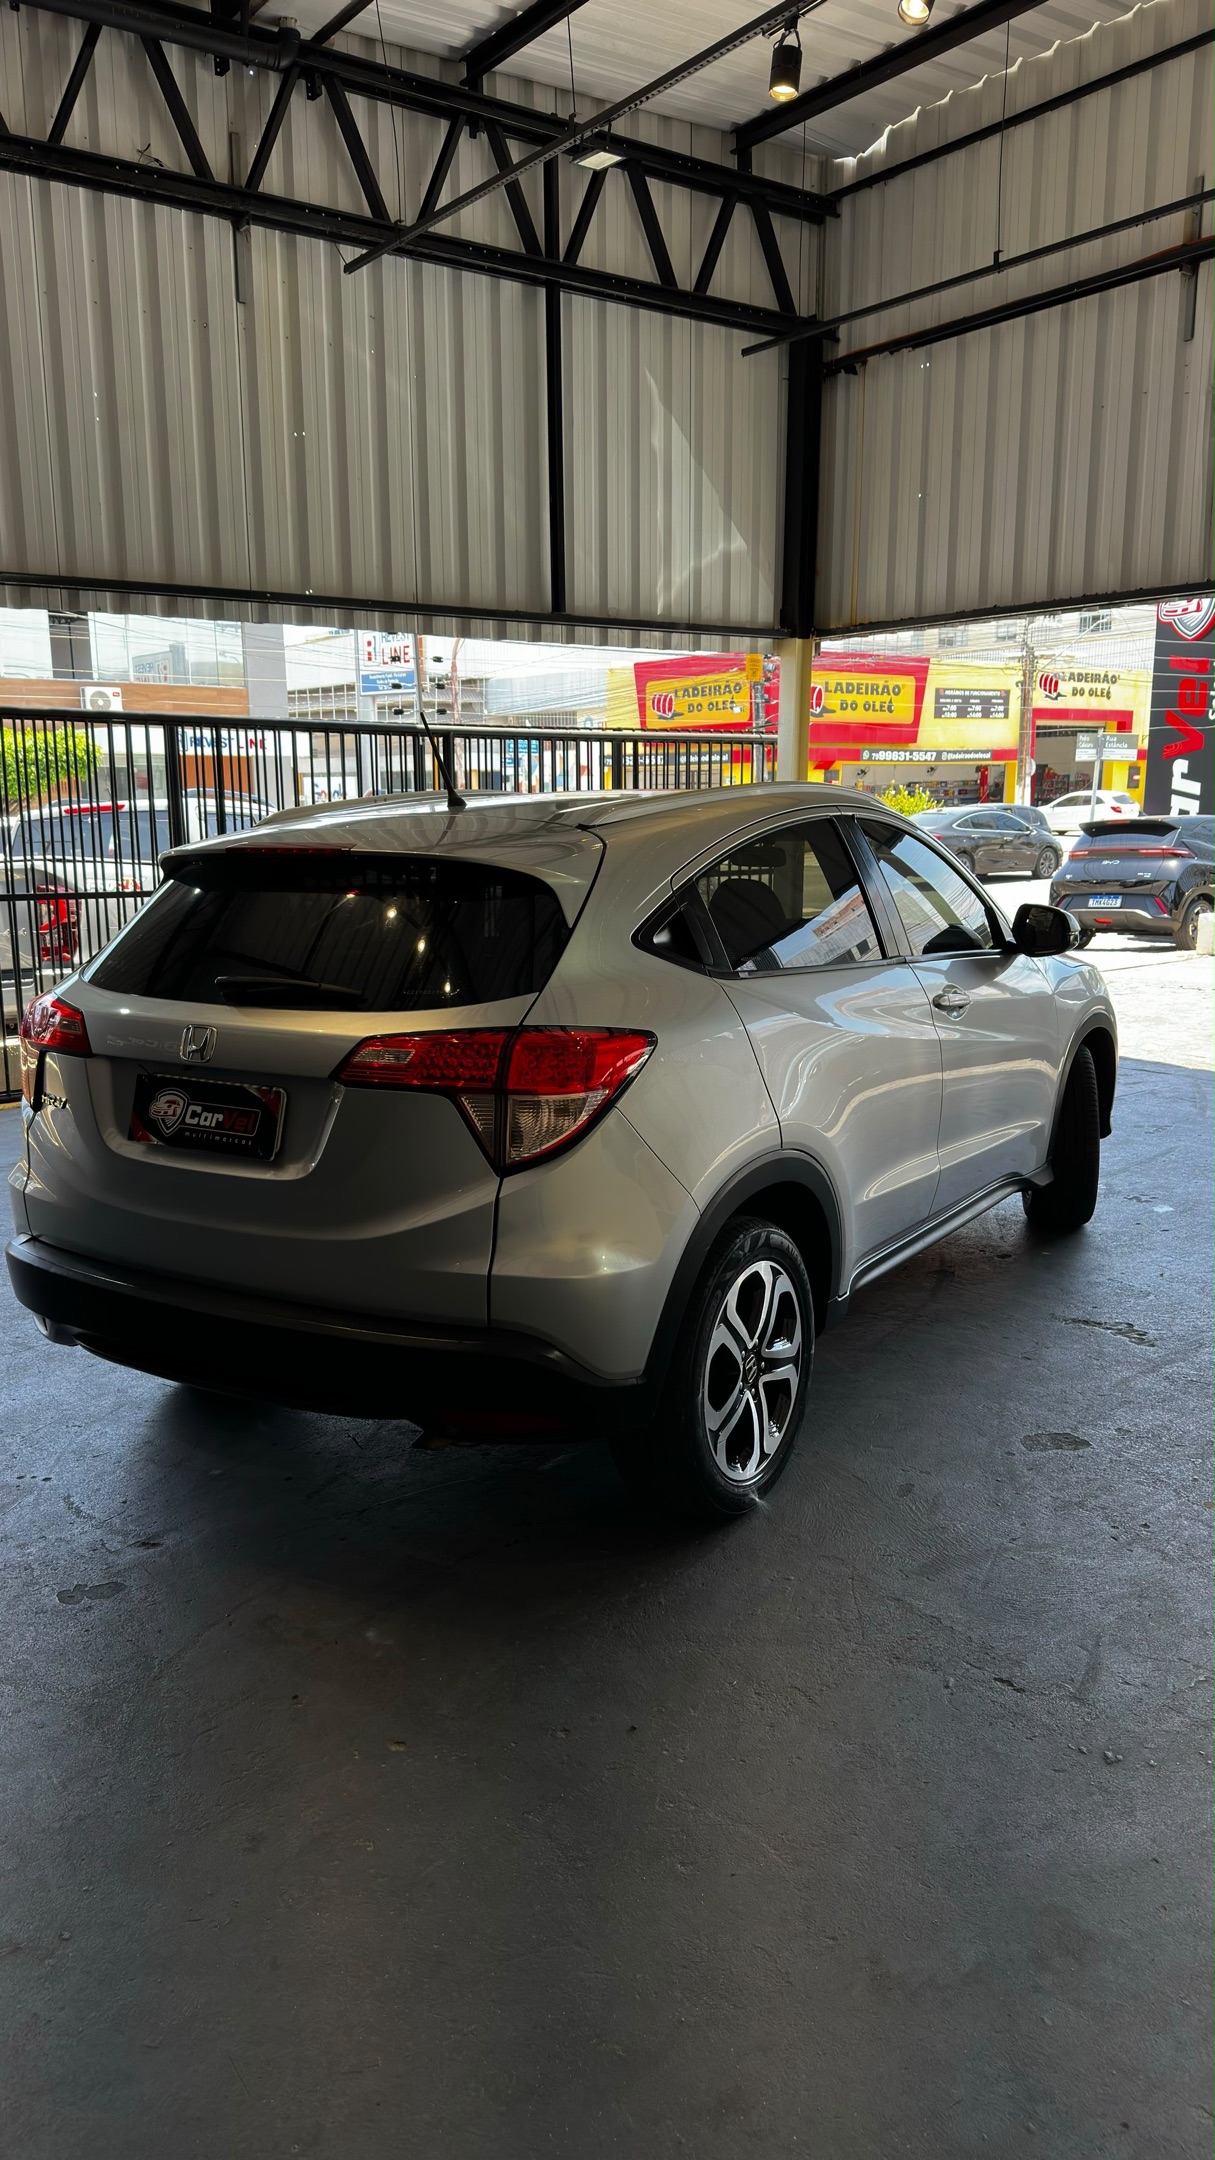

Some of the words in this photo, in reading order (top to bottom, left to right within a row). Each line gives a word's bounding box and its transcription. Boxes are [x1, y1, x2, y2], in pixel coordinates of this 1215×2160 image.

[381, 645, 411, 665] LINE
[674, 680, 743, 699] LADEIRÃO
[825, 679, 902, 697] LADEIRÃO
[1072, 687, 1086, 697] DO
[687, 702, 703, 713] DO
[840, 699, 858, 712] DO
[184, 1104, 256, 1133] CarVel
